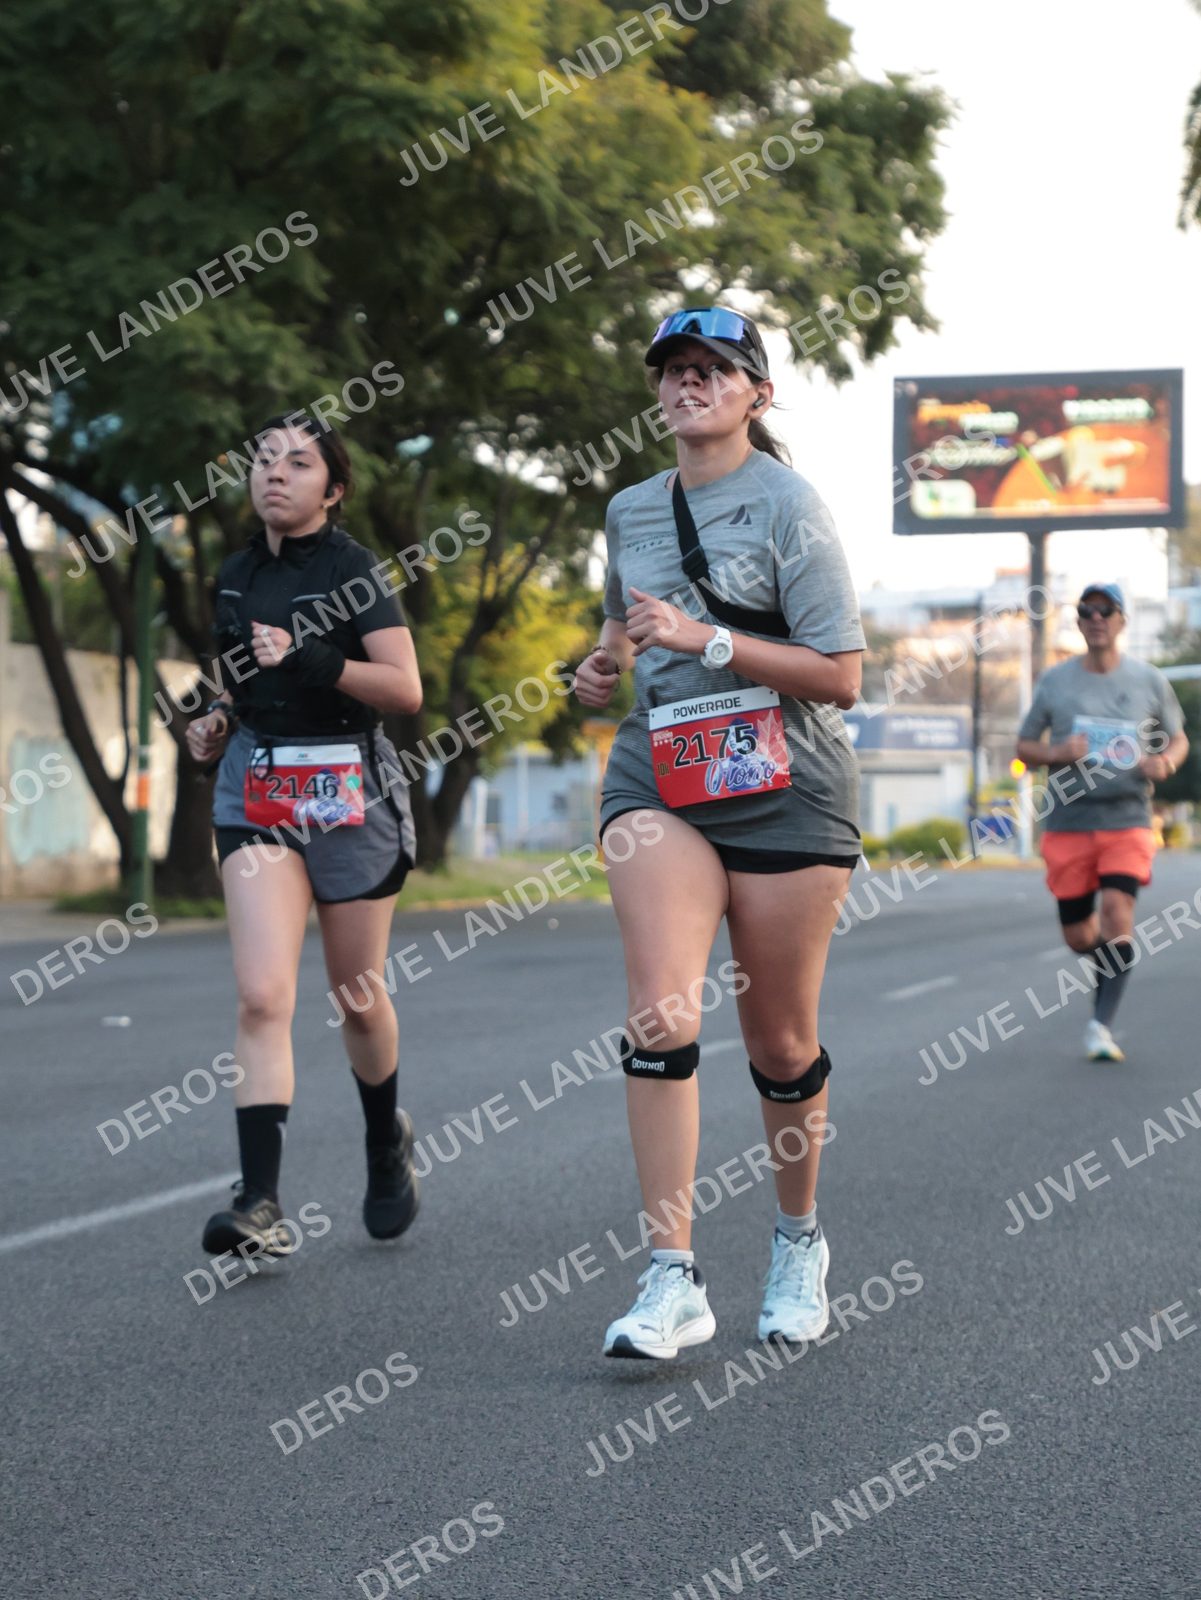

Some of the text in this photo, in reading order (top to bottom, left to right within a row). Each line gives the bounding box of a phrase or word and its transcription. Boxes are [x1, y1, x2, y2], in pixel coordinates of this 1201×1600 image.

[673, 696, 742, 719] POWERADE
[671, 723, 758, 768] 2175
[266, 775, 339, 799] 2146
[632, 1057, 665, 1072] GOUNOD
